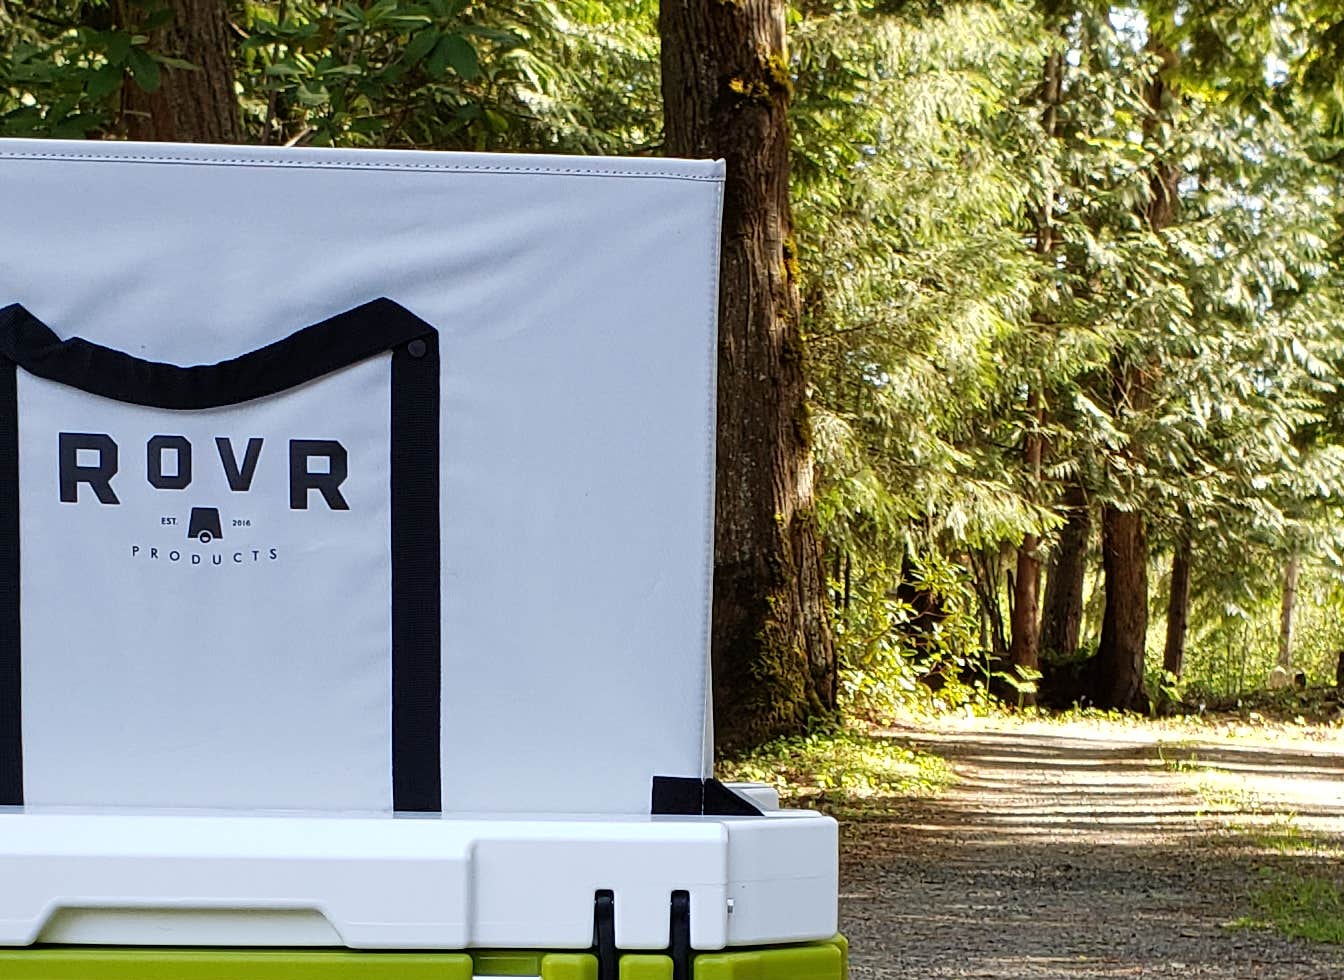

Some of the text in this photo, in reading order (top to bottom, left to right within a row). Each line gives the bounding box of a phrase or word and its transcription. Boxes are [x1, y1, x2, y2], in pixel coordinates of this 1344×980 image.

[58, 431, 351, 511] ROVR
[160, 516, 179, 526] EST.
[131, 545, 278, 566] PRODUCTS
